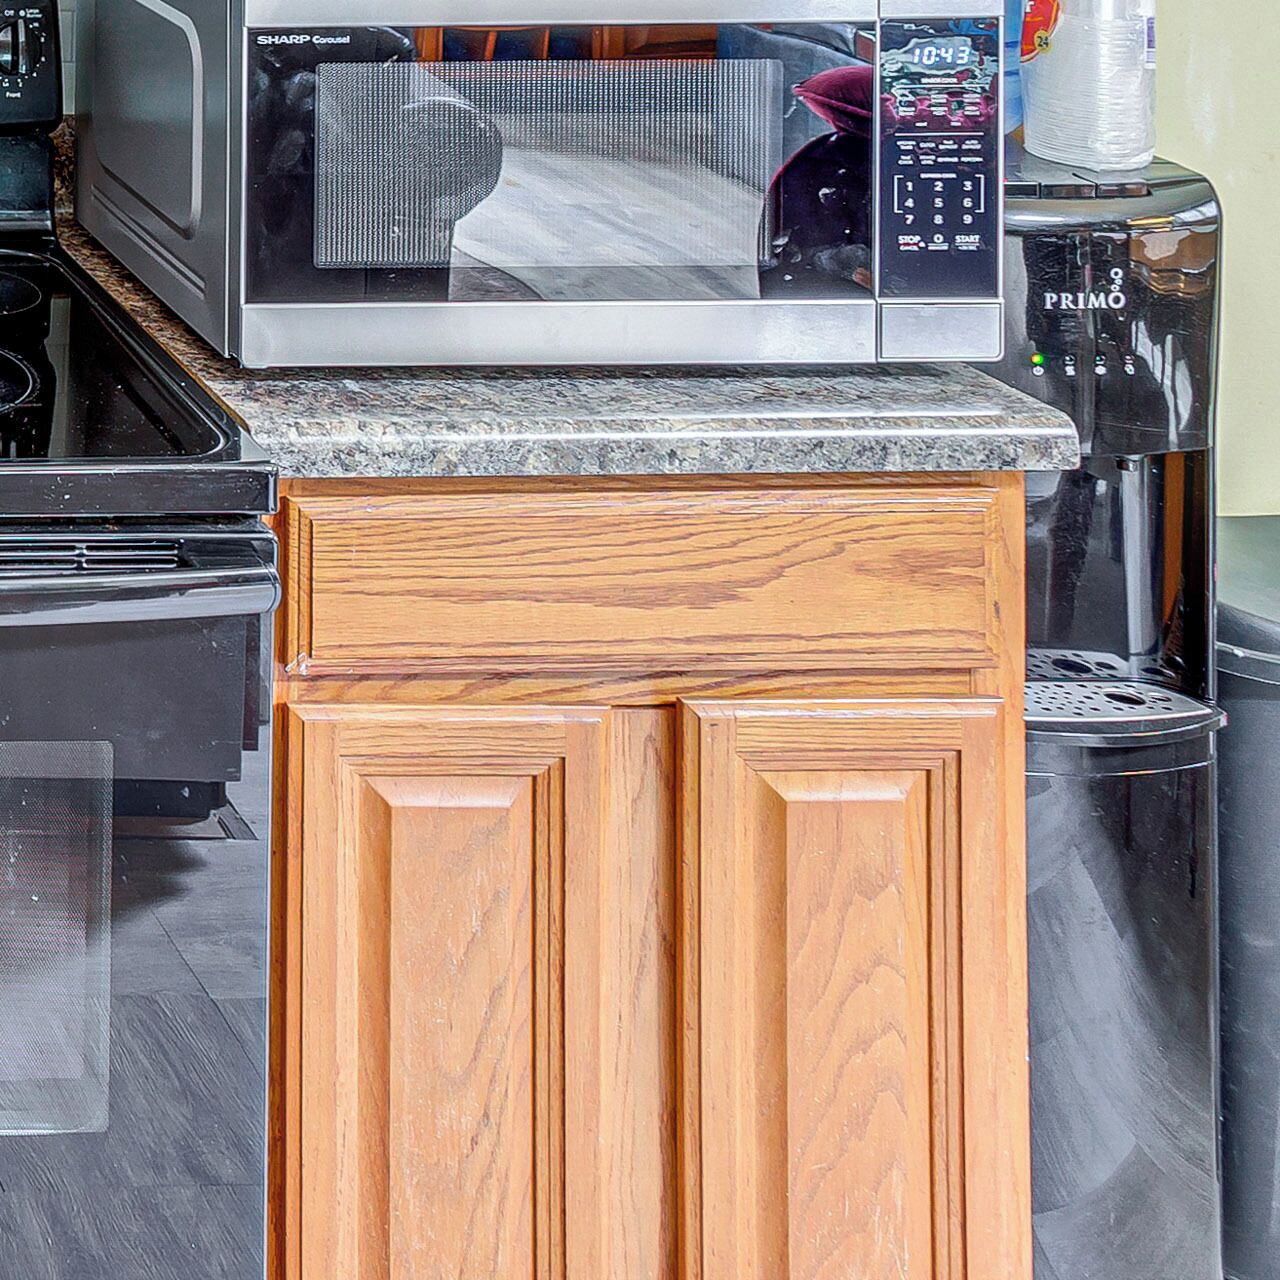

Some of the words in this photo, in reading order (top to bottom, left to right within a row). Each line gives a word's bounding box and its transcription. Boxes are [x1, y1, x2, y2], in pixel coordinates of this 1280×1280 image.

[257, 34, 311, 44] SHARP
[312, 35, 350, 44] Carousel
[912, 46, 970, 65] 10:43
[905, 181, 913, 191] 1
[933, 181, 944, 191] 2
[963, 181, 973, 191] 3
[904, 198, 914, 208] 4
[934, 198, 944, 208] 5
[963, 198, 973, 208] 6
[904, 215, 914, 224] 7
[933, 215, 944, 224] 8
[963, 214, 973, 224] 9
[898, 235, 921, 244] STOP
[933, 234, 944, 243] 0
[955, 235, 980, 243] START
[1043, 292, 1126, 309] PRIMO
